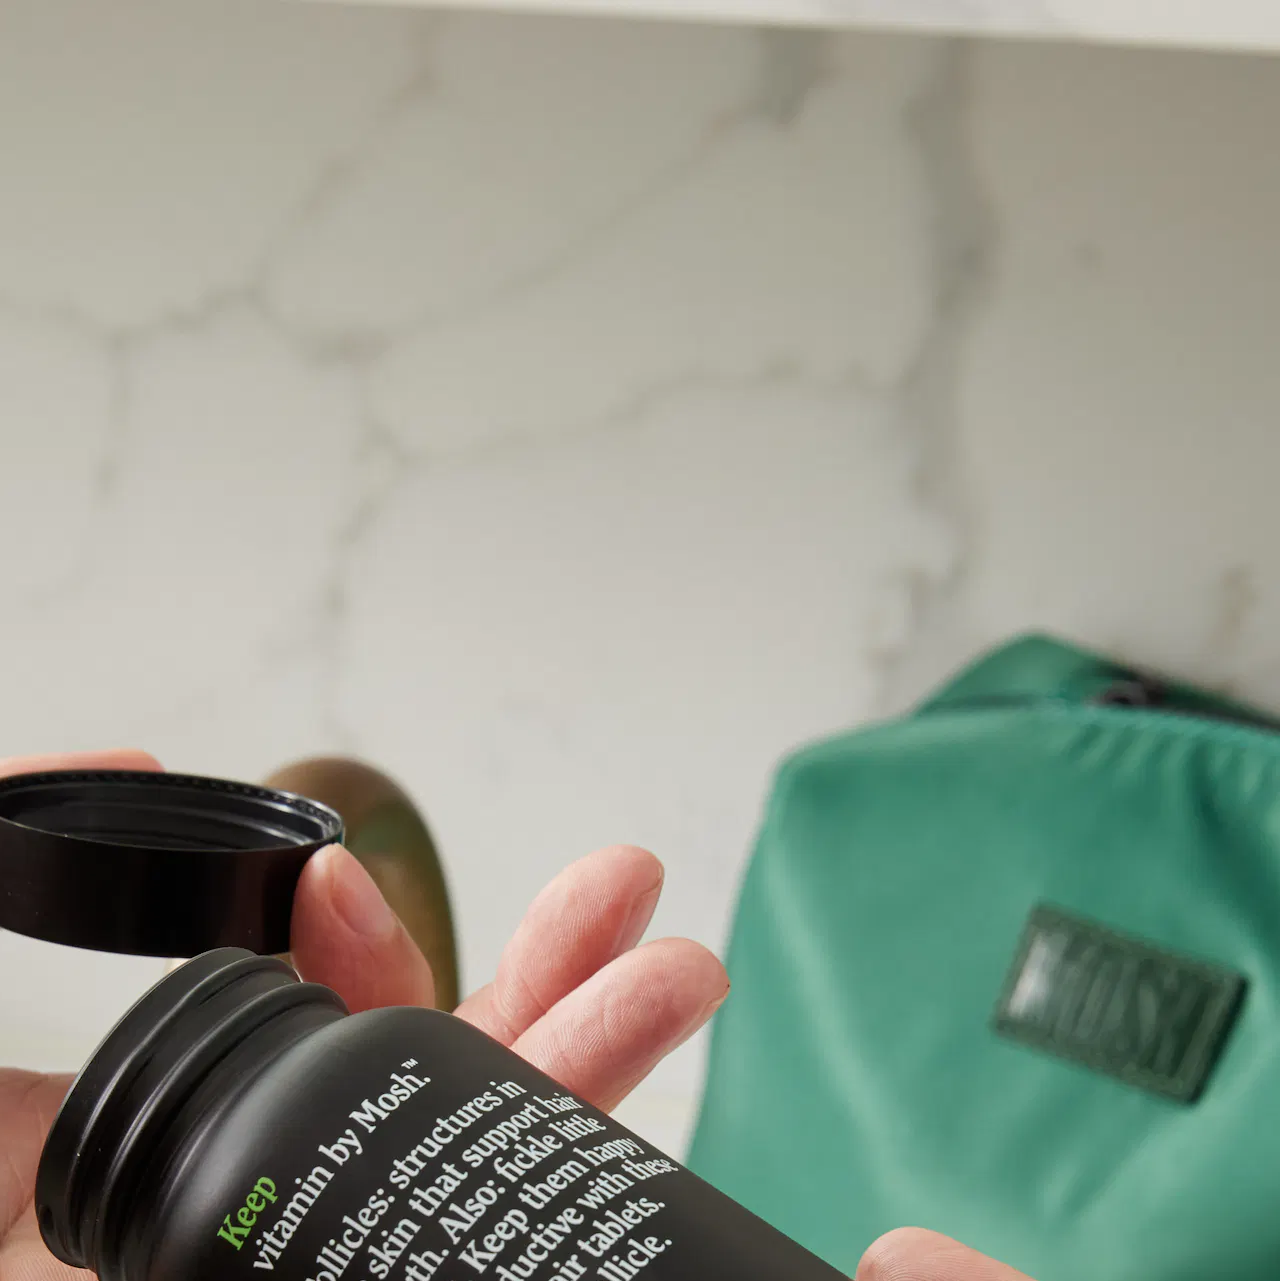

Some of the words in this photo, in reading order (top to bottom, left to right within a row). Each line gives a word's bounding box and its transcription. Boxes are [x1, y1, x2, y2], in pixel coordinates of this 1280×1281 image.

[367, 1218, 422, 1280] skin
[408, 1162, 469, 1217] that
[461, 1101, 550, 1169] support
[532, 1091, 584, 1115] hair
[388, 1090, 504, 1190] structures
[488, 1080, 528, 1100] in
[438, 1179, 506, 1246] Also:
[493, 1134, 564, 1184] fickle
[547, 1113, 607, 1143] little
[575, 1170, 636, 1210] with
[620, 1156, 679, 1182] these
[216, 1176, 279, 1251] Keep
[253, 1165, 335, 1270] vitamin
[317, 1128, 364, 1167] by
[457, 1208, 530, 1274] Keep
[517, 1159, 591, 1210] them
[572, 1137, 643, 1168] happy
[576, 1197, 666, 1258] tablets.
